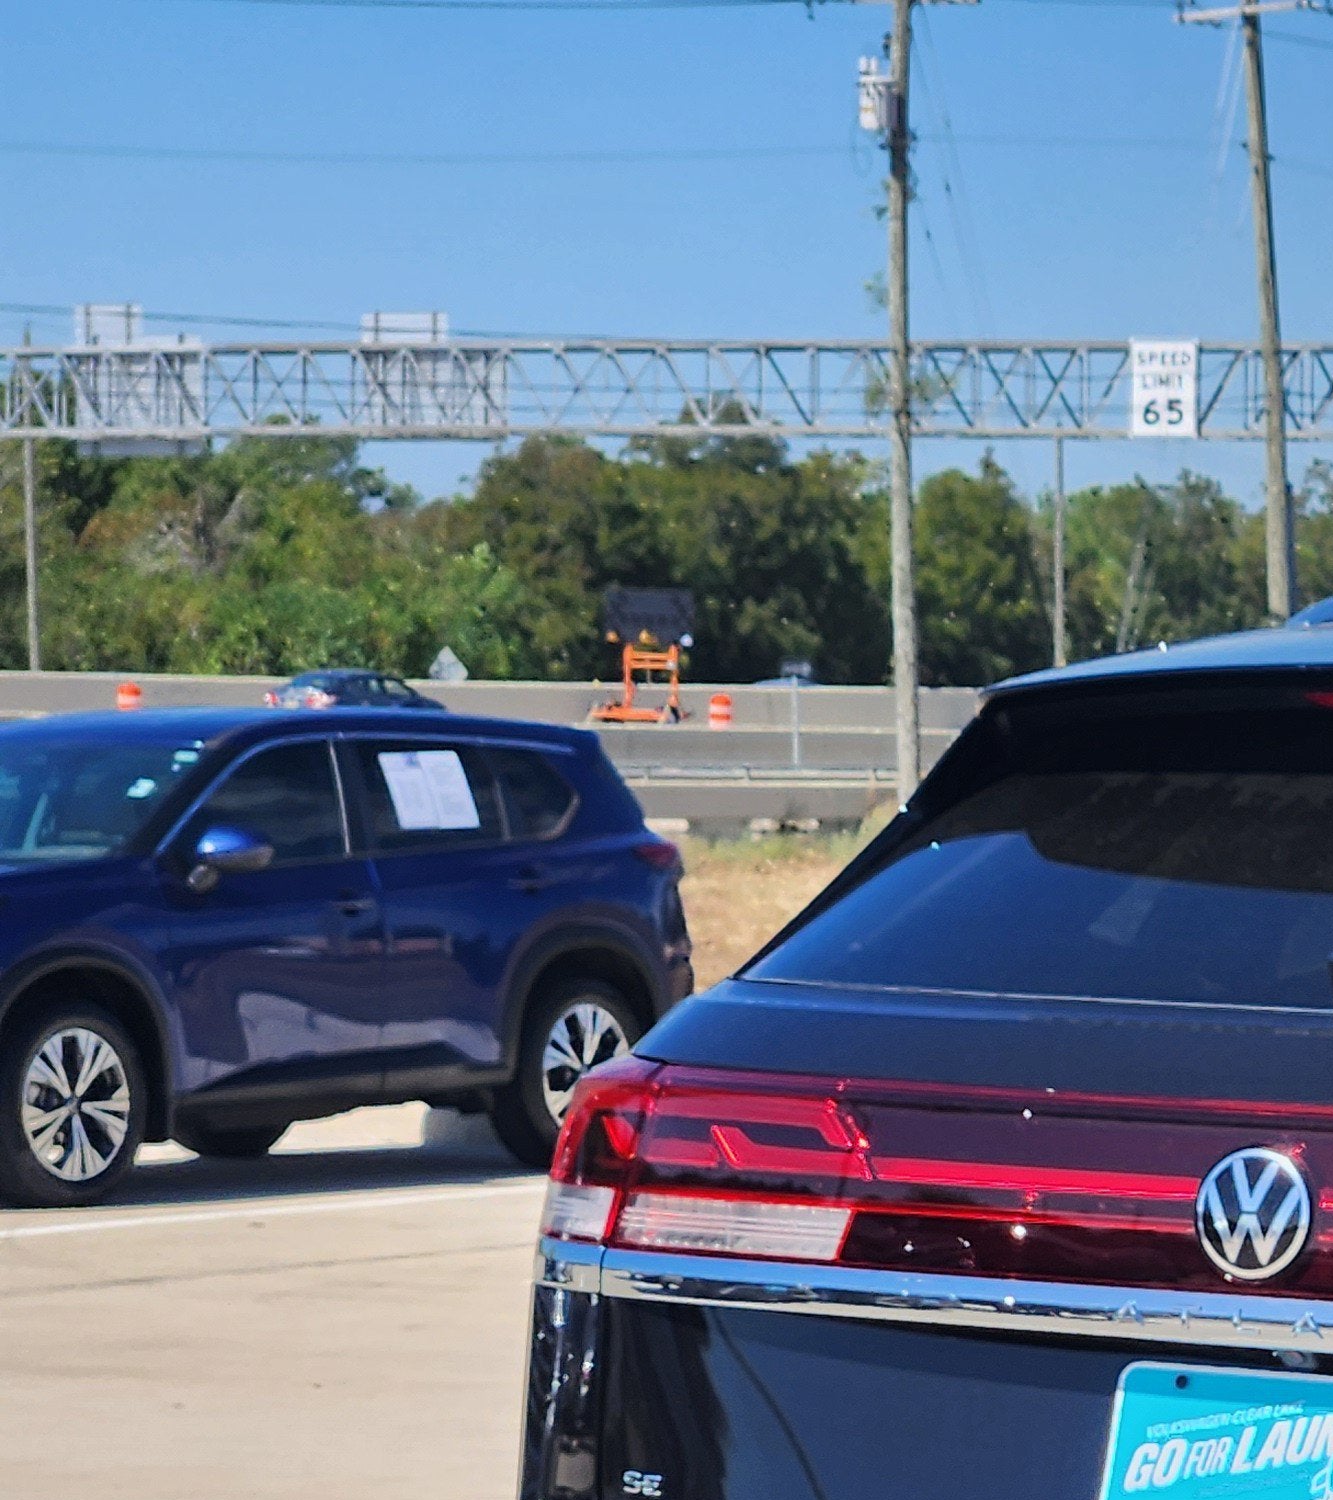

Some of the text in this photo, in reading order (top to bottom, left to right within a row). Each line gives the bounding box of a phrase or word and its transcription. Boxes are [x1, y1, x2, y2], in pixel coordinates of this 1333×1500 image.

[1143, 399, 1183, 425] 65
[1123, 1438, 1188, 1492] GO
[1183, 1436, 1234, 1478] FOR
[622, 1470, 662, 1496] SE
